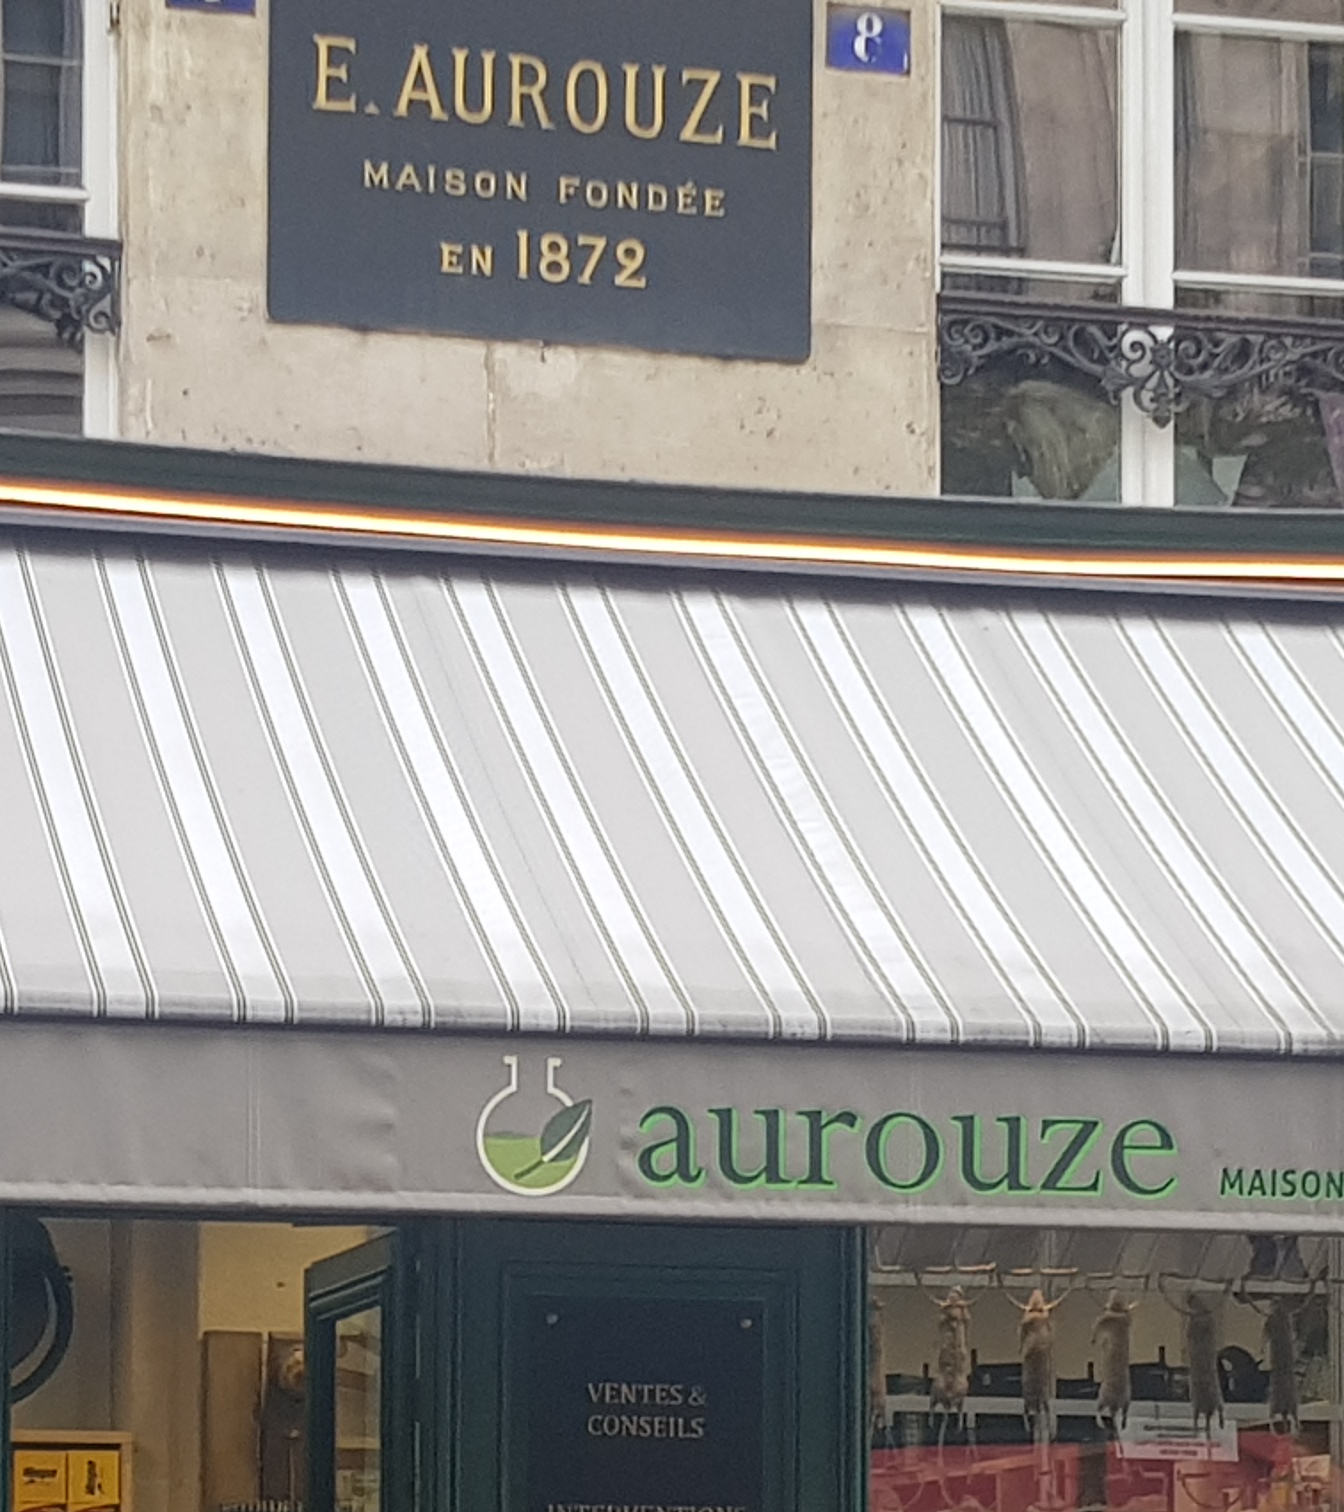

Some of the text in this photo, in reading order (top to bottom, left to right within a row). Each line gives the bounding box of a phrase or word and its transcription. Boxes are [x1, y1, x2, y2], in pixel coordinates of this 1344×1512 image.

[393, 43, 779, 151] AUROUZE
[362, 158, 727, 218] MAISON FONDÉE
[439, 229, 648, 290] EN 1872
[636, 1106, 1178, 1198] aurouze
[1220, 1167, 1344, 1199] MAISON
[587, 1382, 706, 1406] VENTES &
[587, 1414, 706, 1438] CONSEILS
